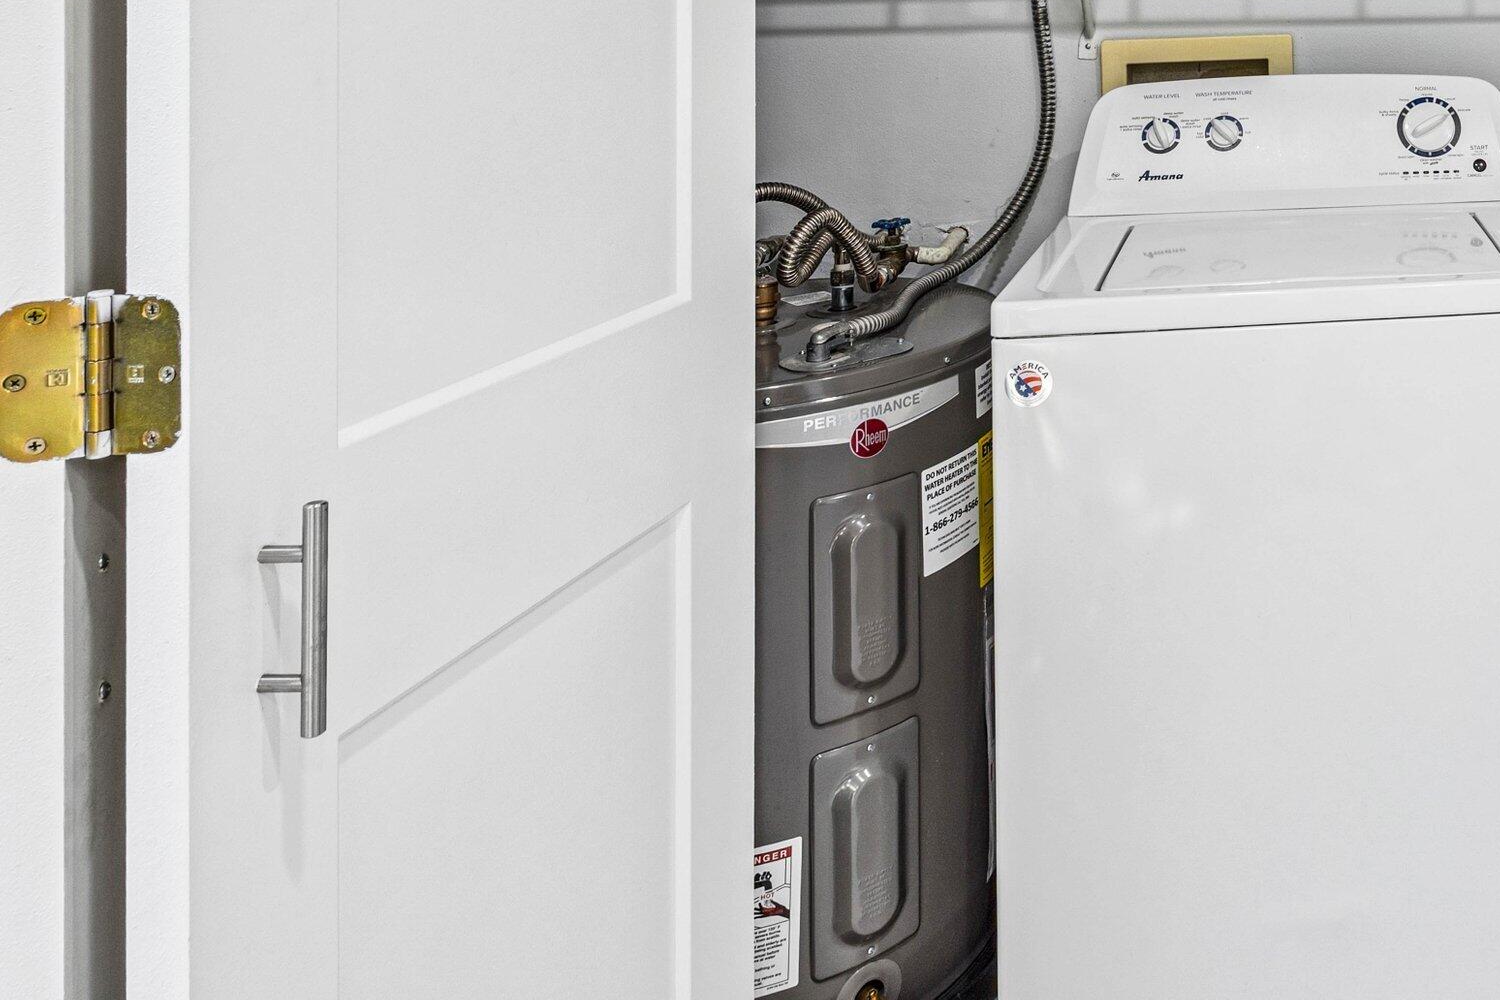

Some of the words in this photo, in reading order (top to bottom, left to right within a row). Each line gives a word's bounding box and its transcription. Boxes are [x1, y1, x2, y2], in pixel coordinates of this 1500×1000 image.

[1138, 170, 1184, 182] Amana
[1009, 362, 1049, 380] AMERICA
[855, 420, 887, 453] Rheem
[924, 478, 944, 492] WATER
[944, 467, 964, 482] HEATER
[964, 463, 970, 471] TO
[970, 457, 978, 467] THE
[925, 472, 935, 481] DO
[936, 465, 947, 476] NOT
[948, 456, 967, 470] RETURN
[967, 449, 977, 459] THIS
[926, 487, 945, 501] PLACE
[945, 482, 953, 492] OF
[953, 468, 976, 488] PURCHASE
[924, 497, 979, 536] 1-866-279-4566
[754, 850, 787, 864] NGER
[760, 892, 774, 900] HOT
